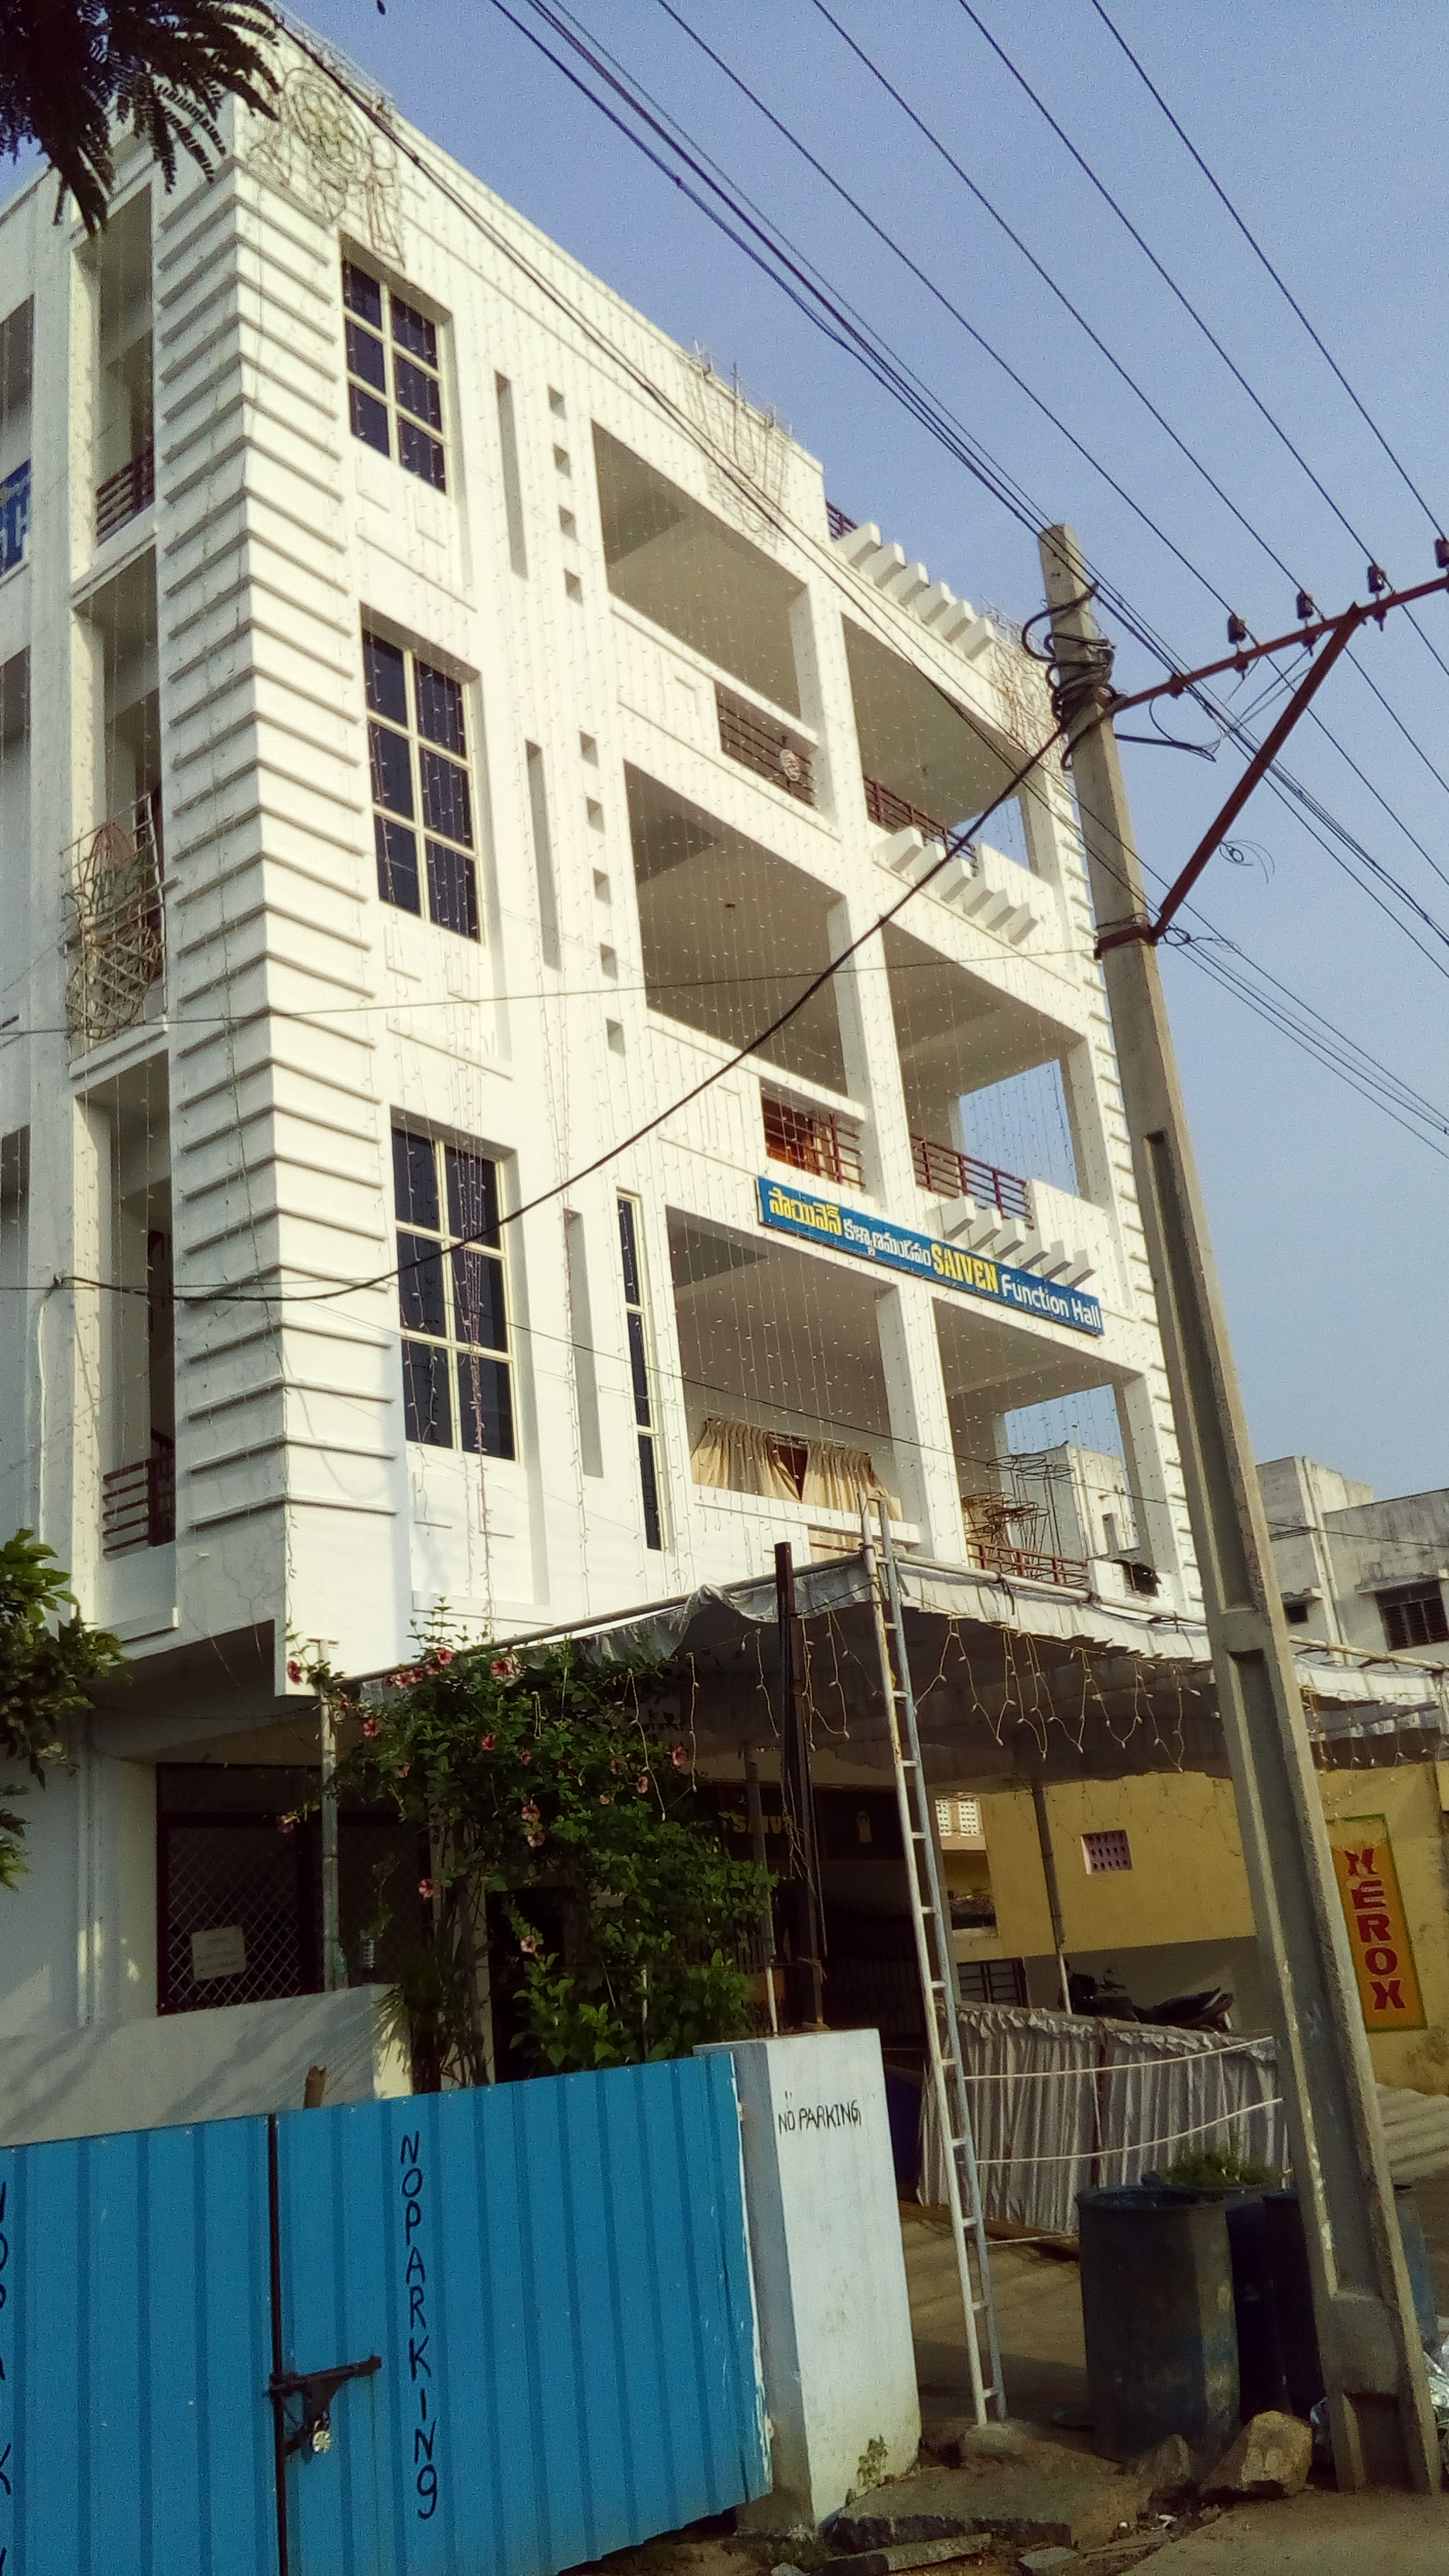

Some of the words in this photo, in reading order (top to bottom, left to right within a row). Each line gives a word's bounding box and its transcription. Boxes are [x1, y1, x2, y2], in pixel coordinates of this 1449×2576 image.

[930, 1243, 999, 1293] SAIVEN
[1001, 1274, 1070, 1318] Function
[1071, 1298, 1102, 1329] Hall
[1345, 1848, 1406, 2009] XEROX
[778, 2110, 796, 2135] NO
[799, 2099, 862, 2132] PARKING
